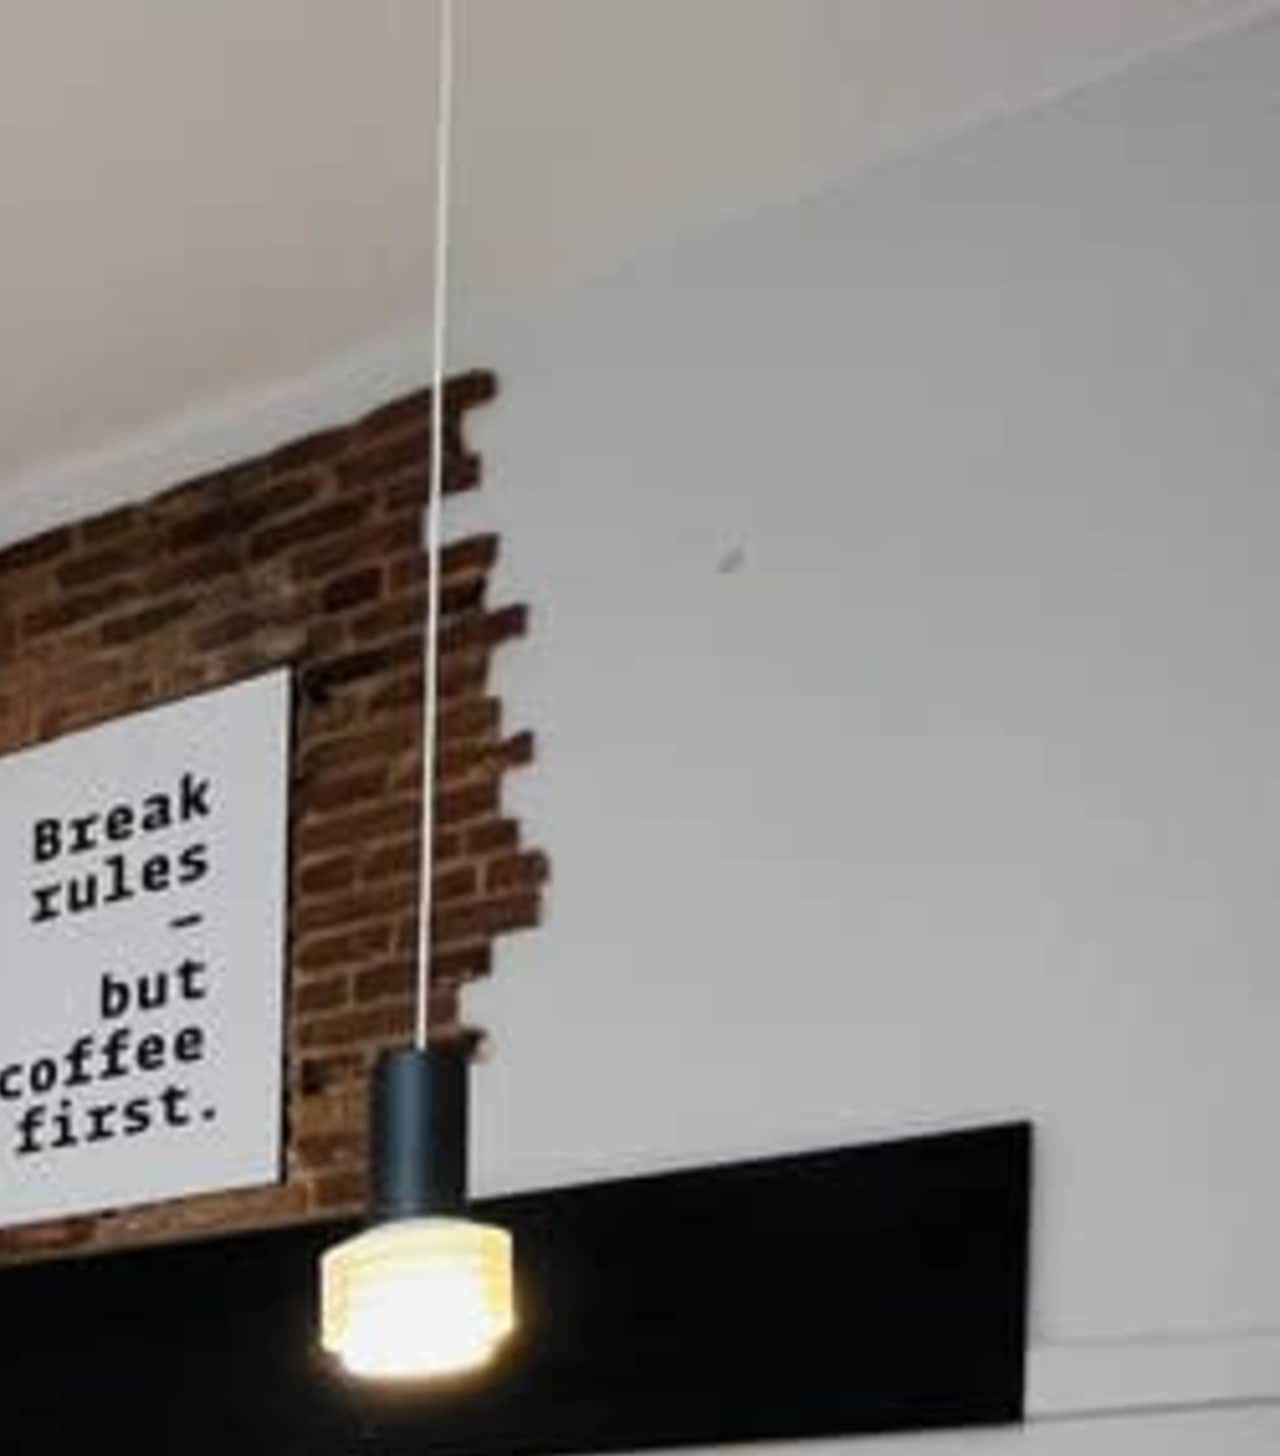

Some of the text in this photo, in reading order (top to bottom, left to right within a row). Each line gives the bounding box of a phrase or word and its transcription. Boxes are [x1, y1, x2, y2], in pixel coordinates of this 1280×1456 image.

[32, 771, 211, 865] Break
[30, 842, 210, 925] rules
[99, 958, 207, 1021] but
[14, 1084, 217, 1156] first.
